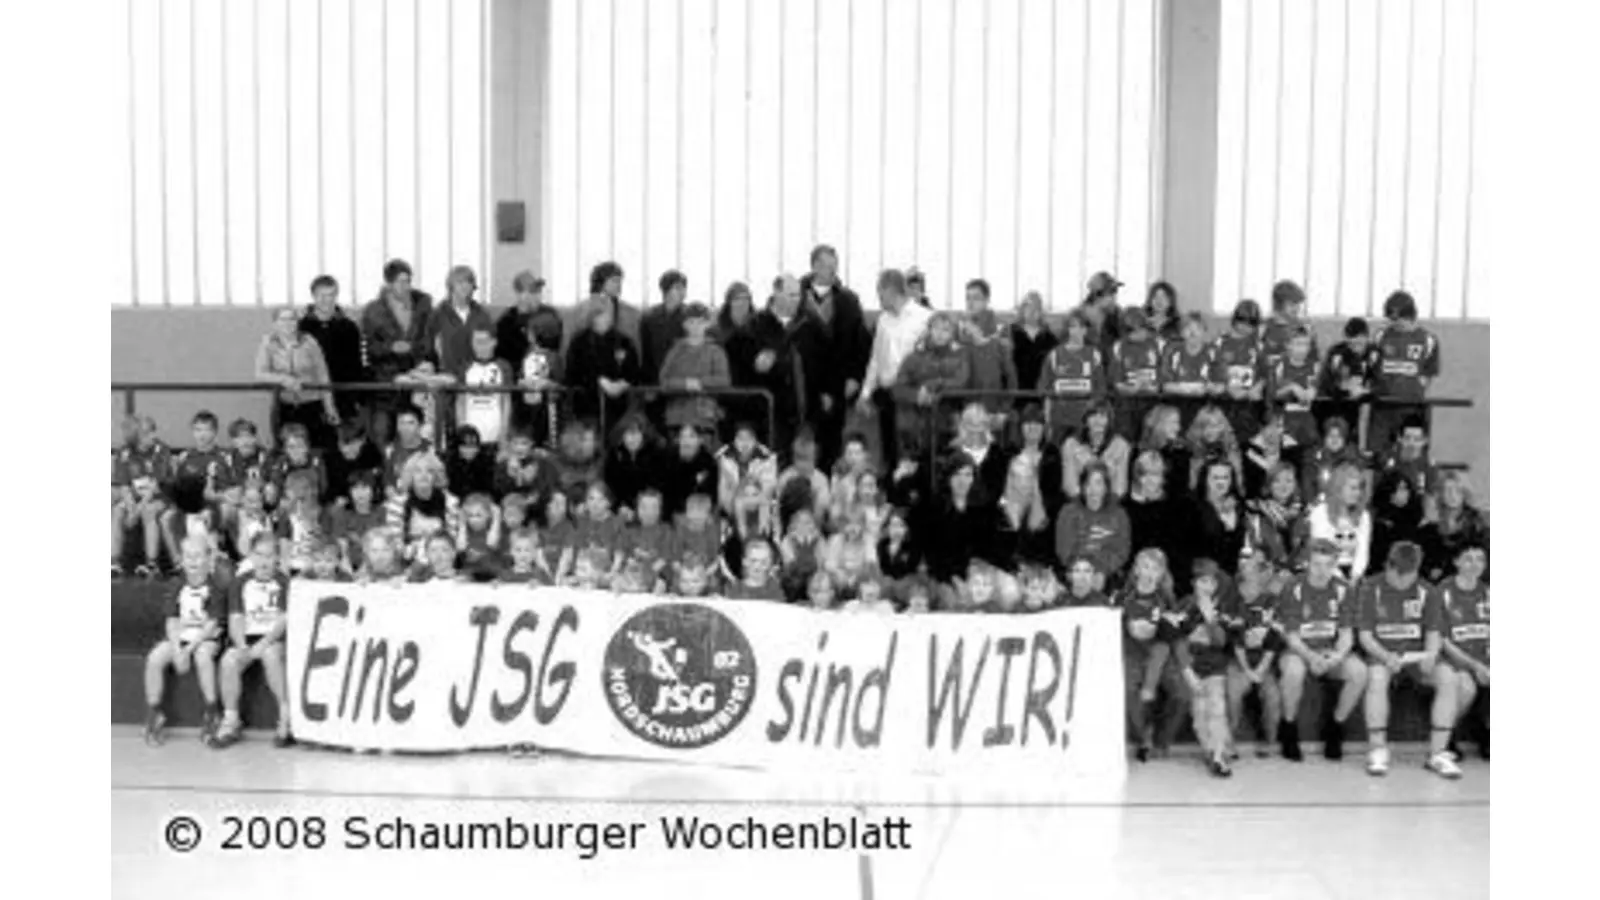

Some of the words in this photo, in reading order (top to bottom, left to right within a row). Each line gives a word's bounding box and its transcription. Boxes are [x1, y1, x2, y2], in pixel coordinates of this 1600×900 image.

[301, 597, 419, 723] Eine
[450, 605, 580, 727] JSG
[610, 667, 750, 742] NORDSCHAUMBURG
[651, 682, 716, 715] JSG
[766, 630, 899, 748] sind
[927, 626, 1081, 750] WIR!
